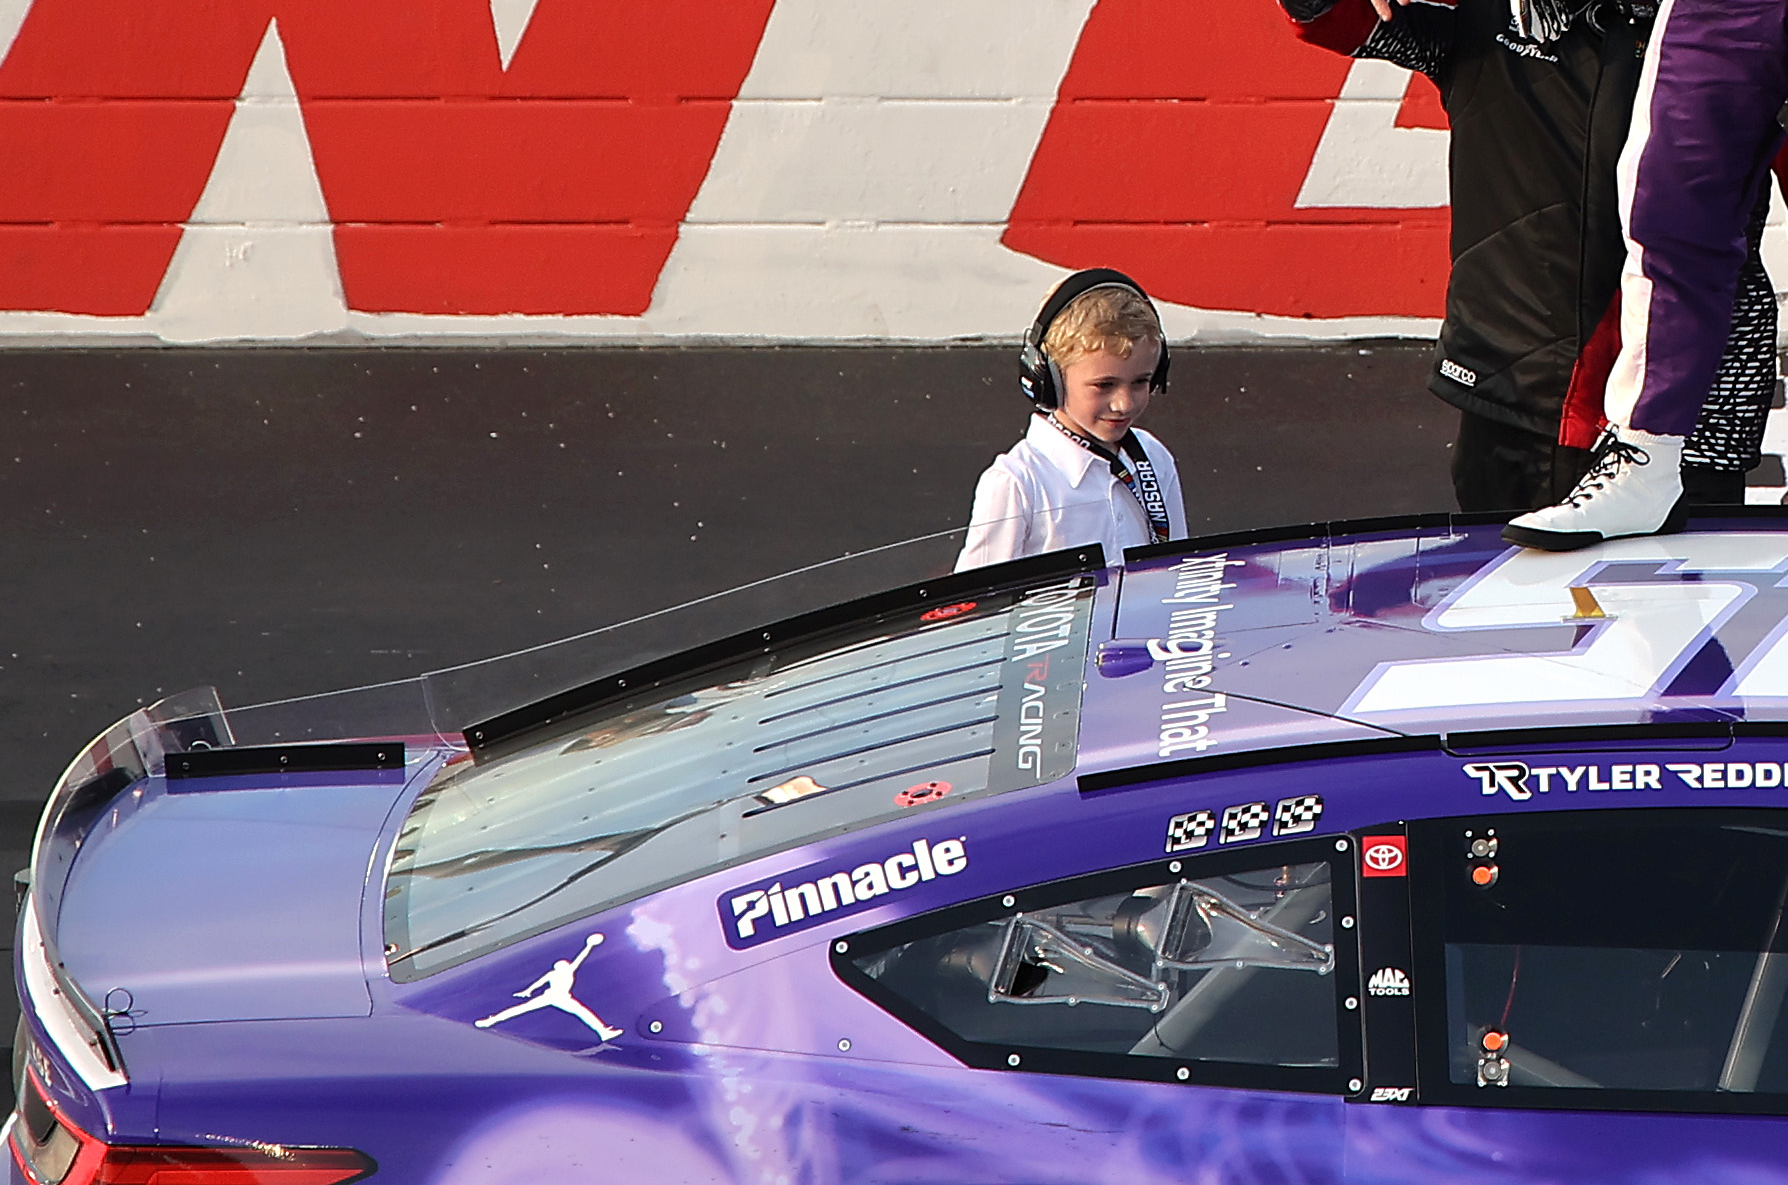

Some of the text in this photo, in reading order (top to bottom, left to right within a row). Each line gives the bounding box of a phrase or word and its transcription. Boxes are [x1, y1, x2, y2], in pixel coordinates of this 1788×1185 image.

[1440, 359, 1477, 387] sparco
[1136, 459, 1168, 524] NASCAR
[1146, 604, 1233, 694] Imagine
[1016, 653, 1052, 780] RACING
[1157, 693, 1228, 758] That
[1531, 765, 1662, 792] TYLER
[730, 835, 968, 939] Pinnacle
[1368, 967, 1411, 988] MAC
[1368, 987, 1411, 996] TOOLS
